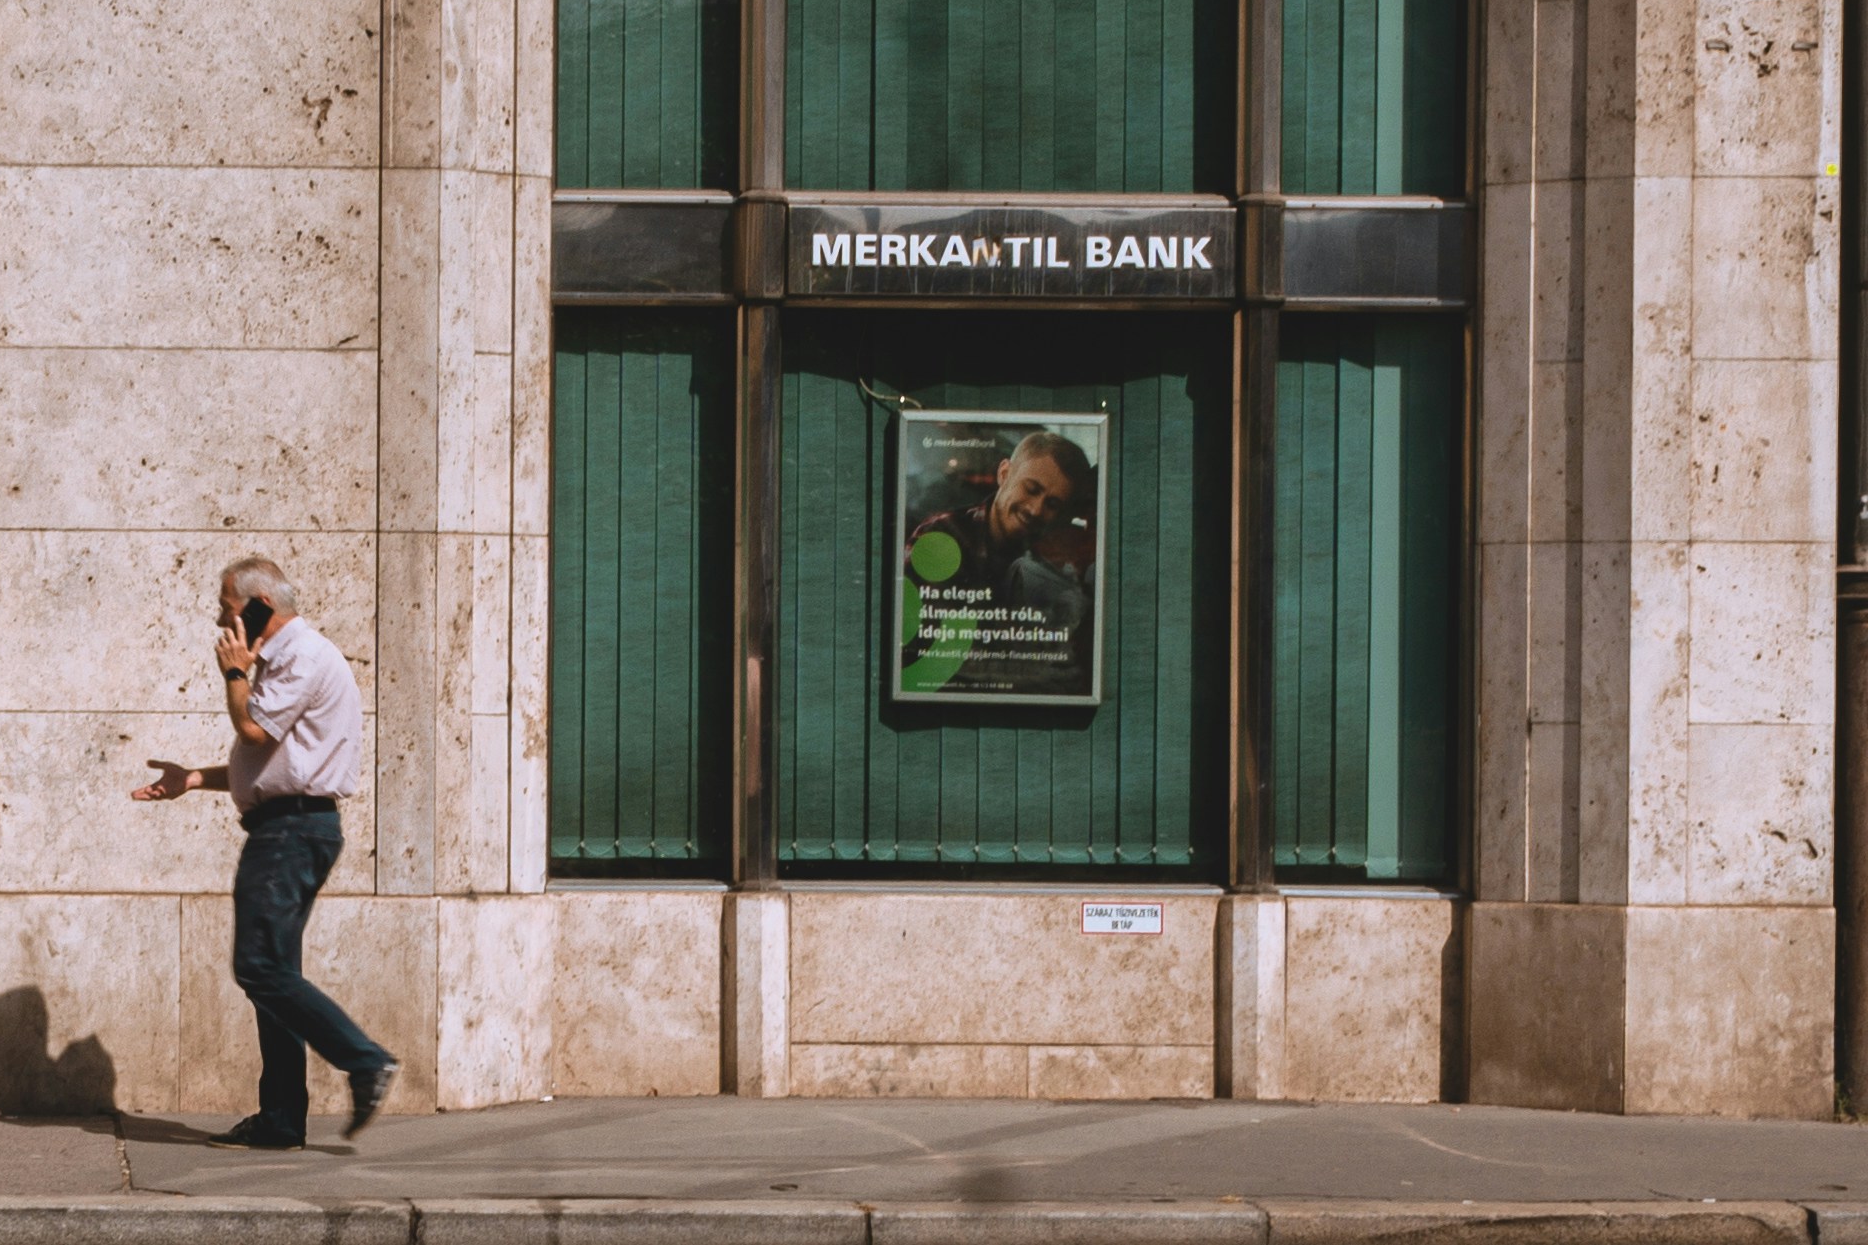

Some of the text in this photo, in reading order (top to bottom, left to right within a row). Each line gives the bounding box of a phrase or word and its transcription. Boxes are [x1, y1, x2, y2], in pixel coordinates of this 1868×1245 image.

[812, 234, 1213, 270] MERKANTIL BANK
[919, 586, 992, 604] Ha eleget
[918, 605, 1047, 624] álmodozott róla,
[918, 624, 1069, 644] ideje megvalósítani
